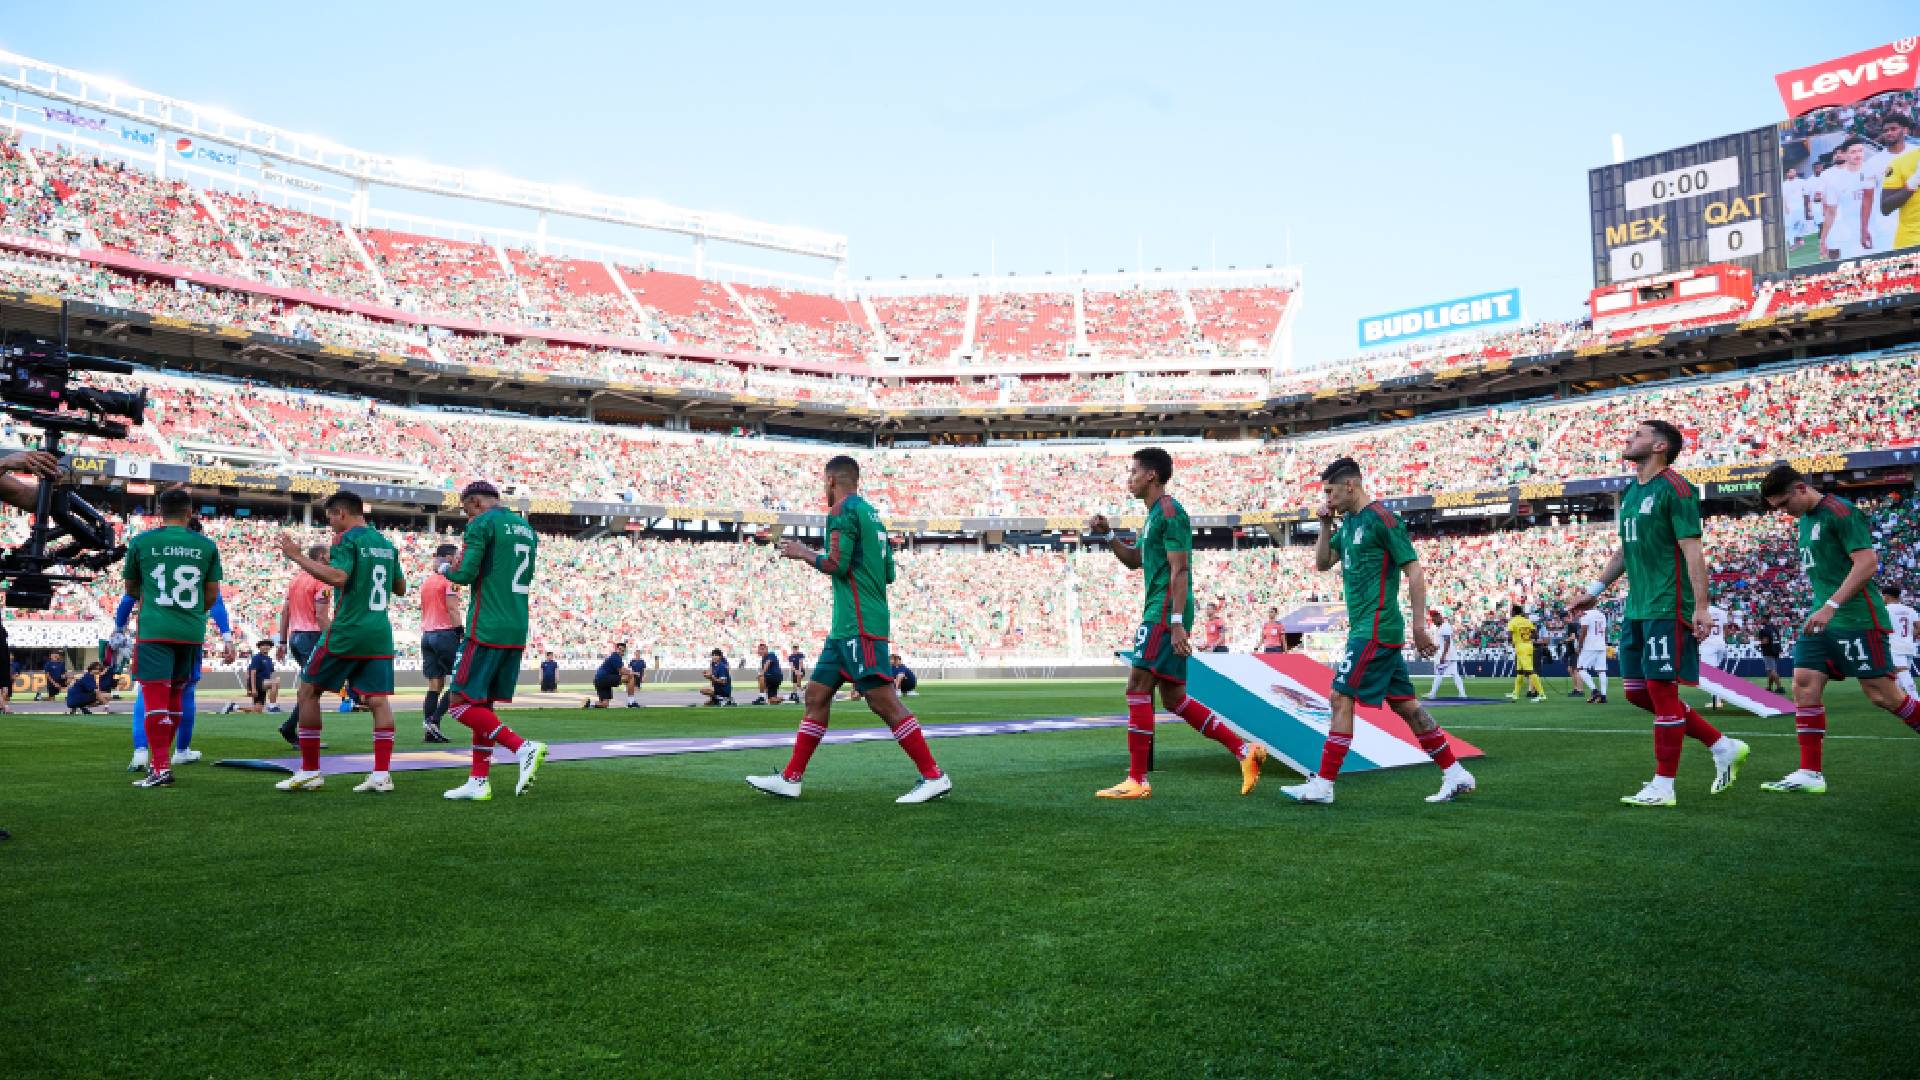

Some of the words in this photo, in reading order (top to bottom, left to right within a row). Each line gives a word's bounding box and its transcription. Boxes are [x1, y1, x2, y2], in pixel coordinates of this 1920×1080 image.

[1652, 169, 1708, 199] 0:00
[1703, 192, 1766, 225] QAT
[1605, 214, 1668, 246] MEX
[1727, 230, 1743, 251] 0
[1630, 251, 1644, 271] 0
[1364, 312, 1422, 342] BUD
[1422, 293, 1513, 330] LIGHT
[72, 457, 107, 473] QAT
[128, 463, 139, 476] 0
[1623, 517, 1638, 542] 11
[511, 543, 532, 594] 2
[149, 563, 201, 609] 18
[369, 564, 387, 611] 8
[846, 638, 858, 662] 7
[1647, 635, 1670, 661] 11
